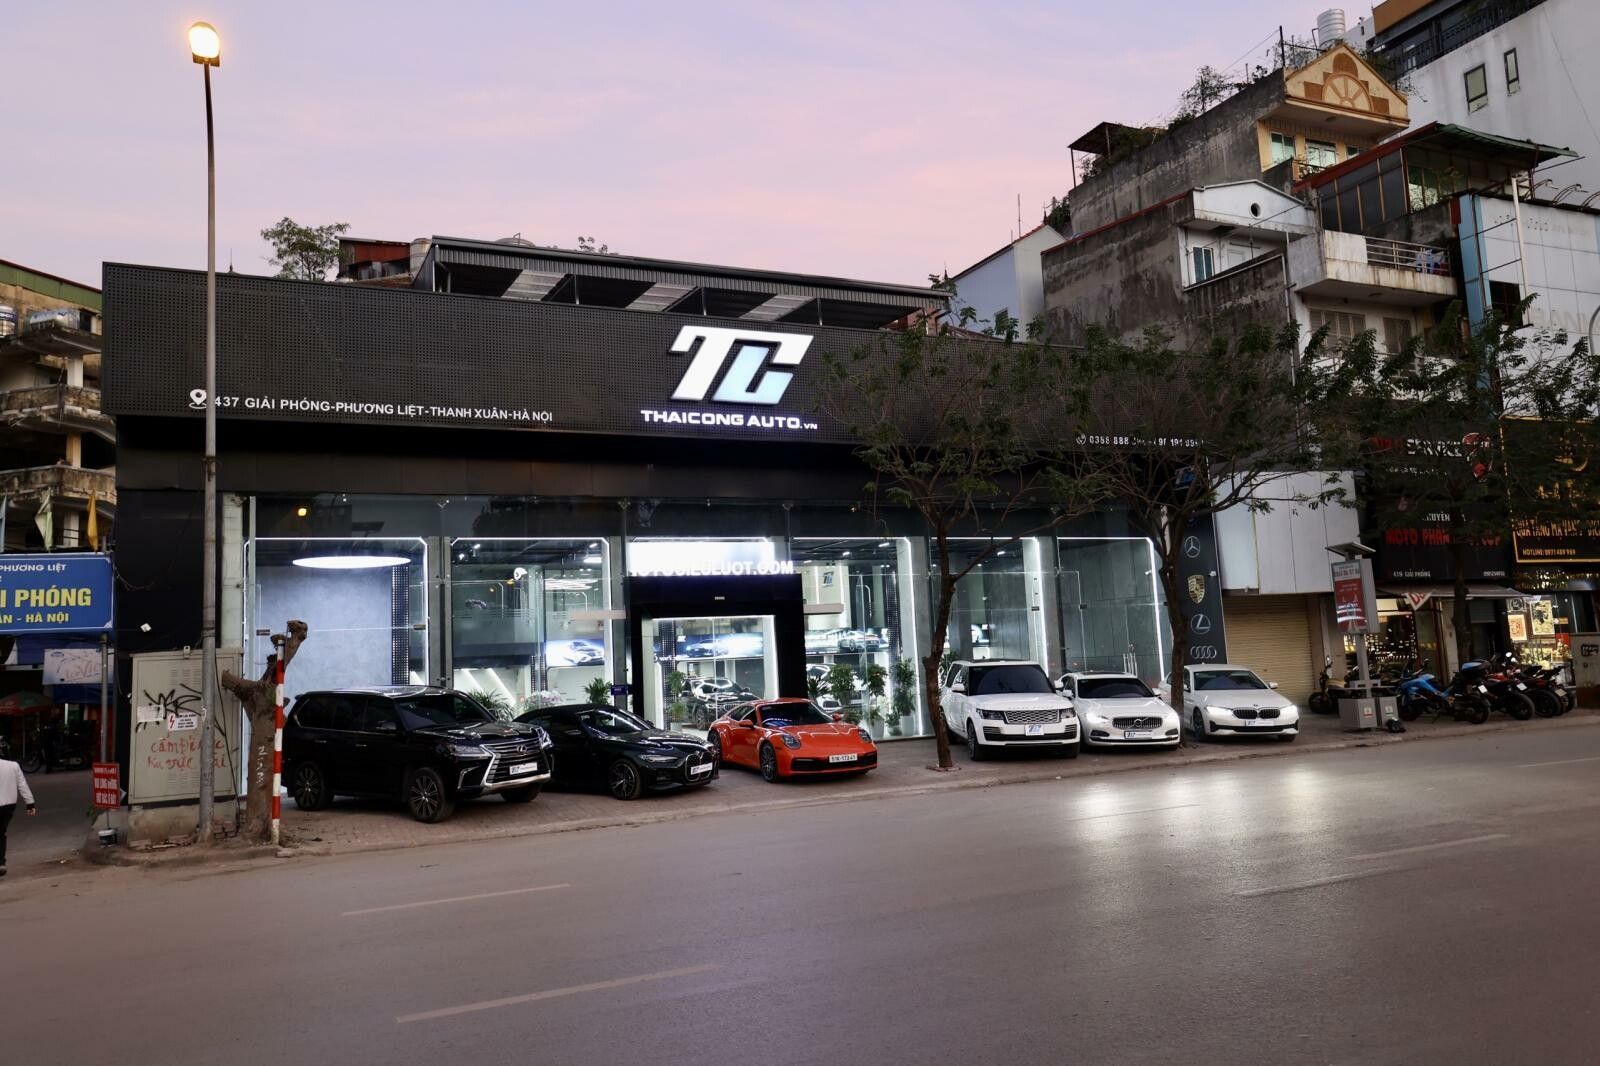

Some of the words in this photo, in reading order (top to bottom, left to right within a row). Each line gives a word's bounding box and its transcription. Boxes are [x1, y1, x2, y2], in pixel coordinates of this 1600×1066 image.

[214, 396, 239, 407] 437
[244, 395, 275, 409] GIẢI
[397, 404, 472, 419] LIỆT-THANH
[474, 406, 530, 421] XUÂN-HÀ
[532, 411, 553, 424] NỘI
[640, 409, 744, 426] THAICONG
[47, 562, 66, 573] LIỆT
[14, 585, 92, 608] PHÓNG
[25, 612, 43, 623] HÀ
[47, 612, 69, 623] NỘI
